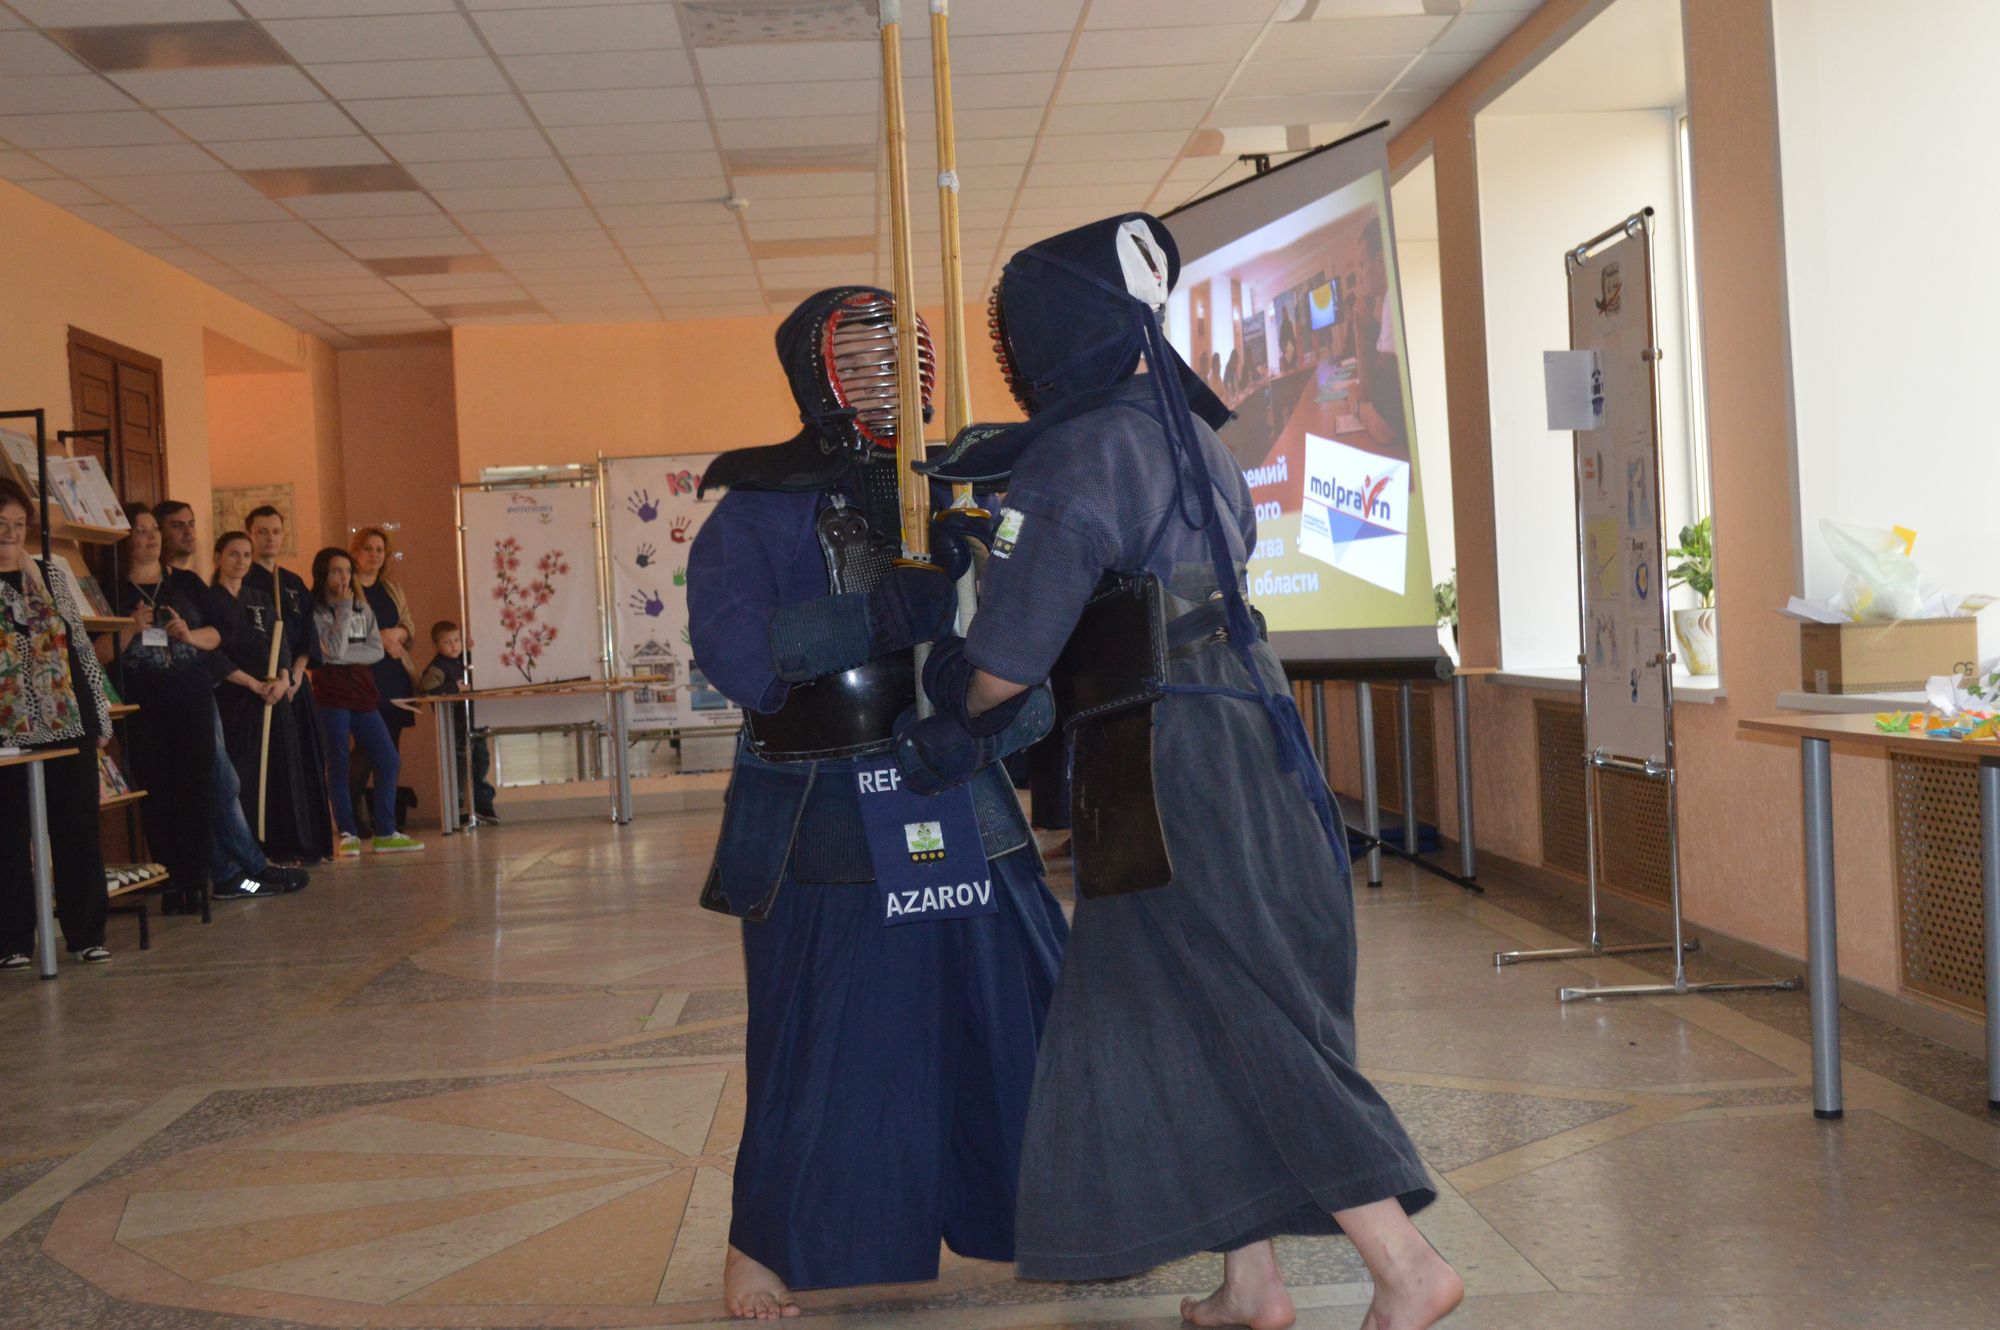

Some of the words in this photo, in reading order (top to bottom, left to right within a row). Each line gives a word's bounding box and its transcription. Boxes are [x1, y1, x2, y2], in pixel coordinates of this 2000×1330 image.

[1242, 455, 1288, 488] емий
[1250, 538, 1284, 560] ства
[1254, 569, 1319, 597] области
[886, 880, 991, 918] AZAROV
